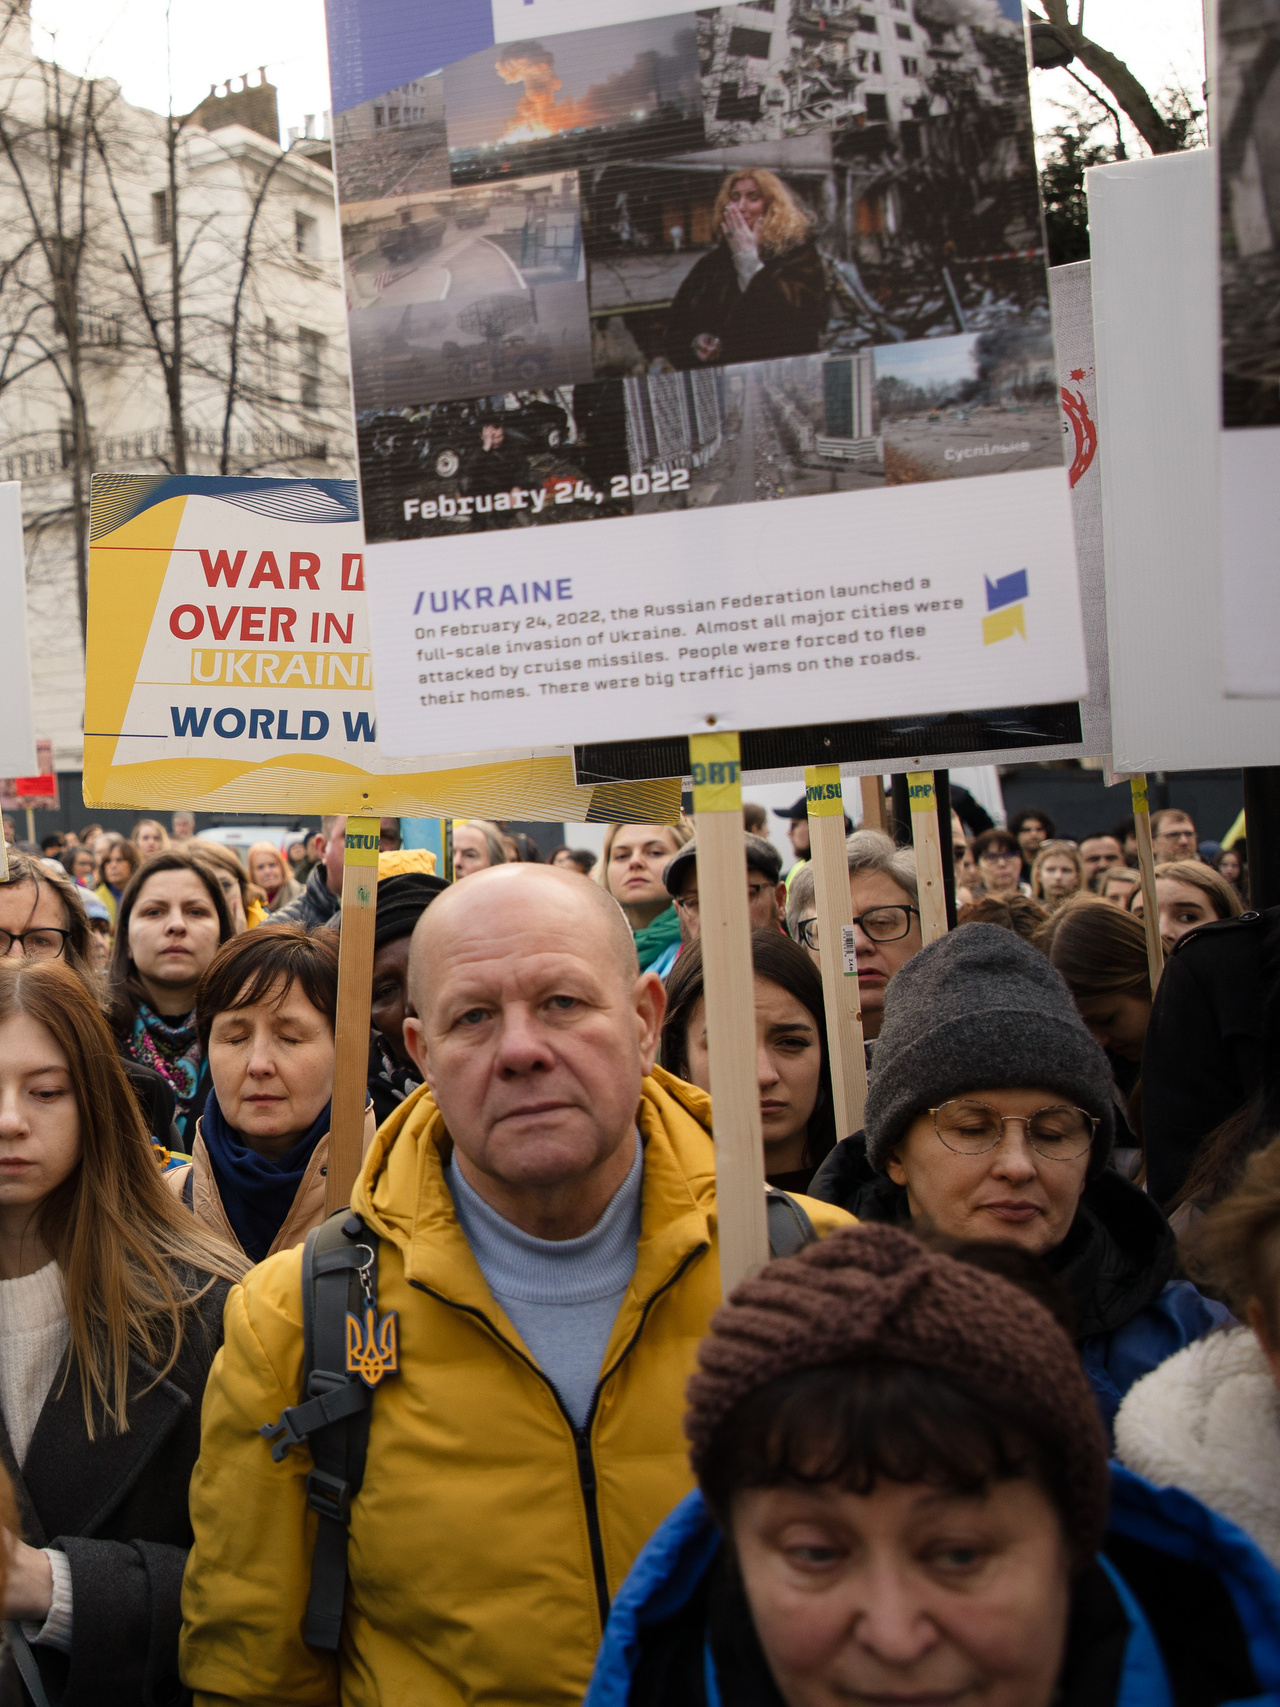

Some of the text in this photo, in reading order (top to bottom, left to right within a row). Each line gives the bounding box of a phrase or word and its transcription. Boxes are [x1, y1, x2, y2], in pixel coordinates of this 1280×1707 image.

[403, 469, 690, 521] February 24, 2022
[198, 549, 321, 590] WAR
[413, 577, 573, 615] /UKRAINE
[415, 577, 931, 640] On February 24, 2022, the Russian Federation launched a
[169, 604, 354, 644] OVER IN
[417, 598, 964, 662] full-scale invasion of Ukraine. Almost all major cities were
[418, 624, 926, 684] attacked by cruise missiles. People were forced to flee
[420, 648, 921, 707] their homes. There were big traffic jams on the roads.
[170, 706, 330, 741] WORLD
